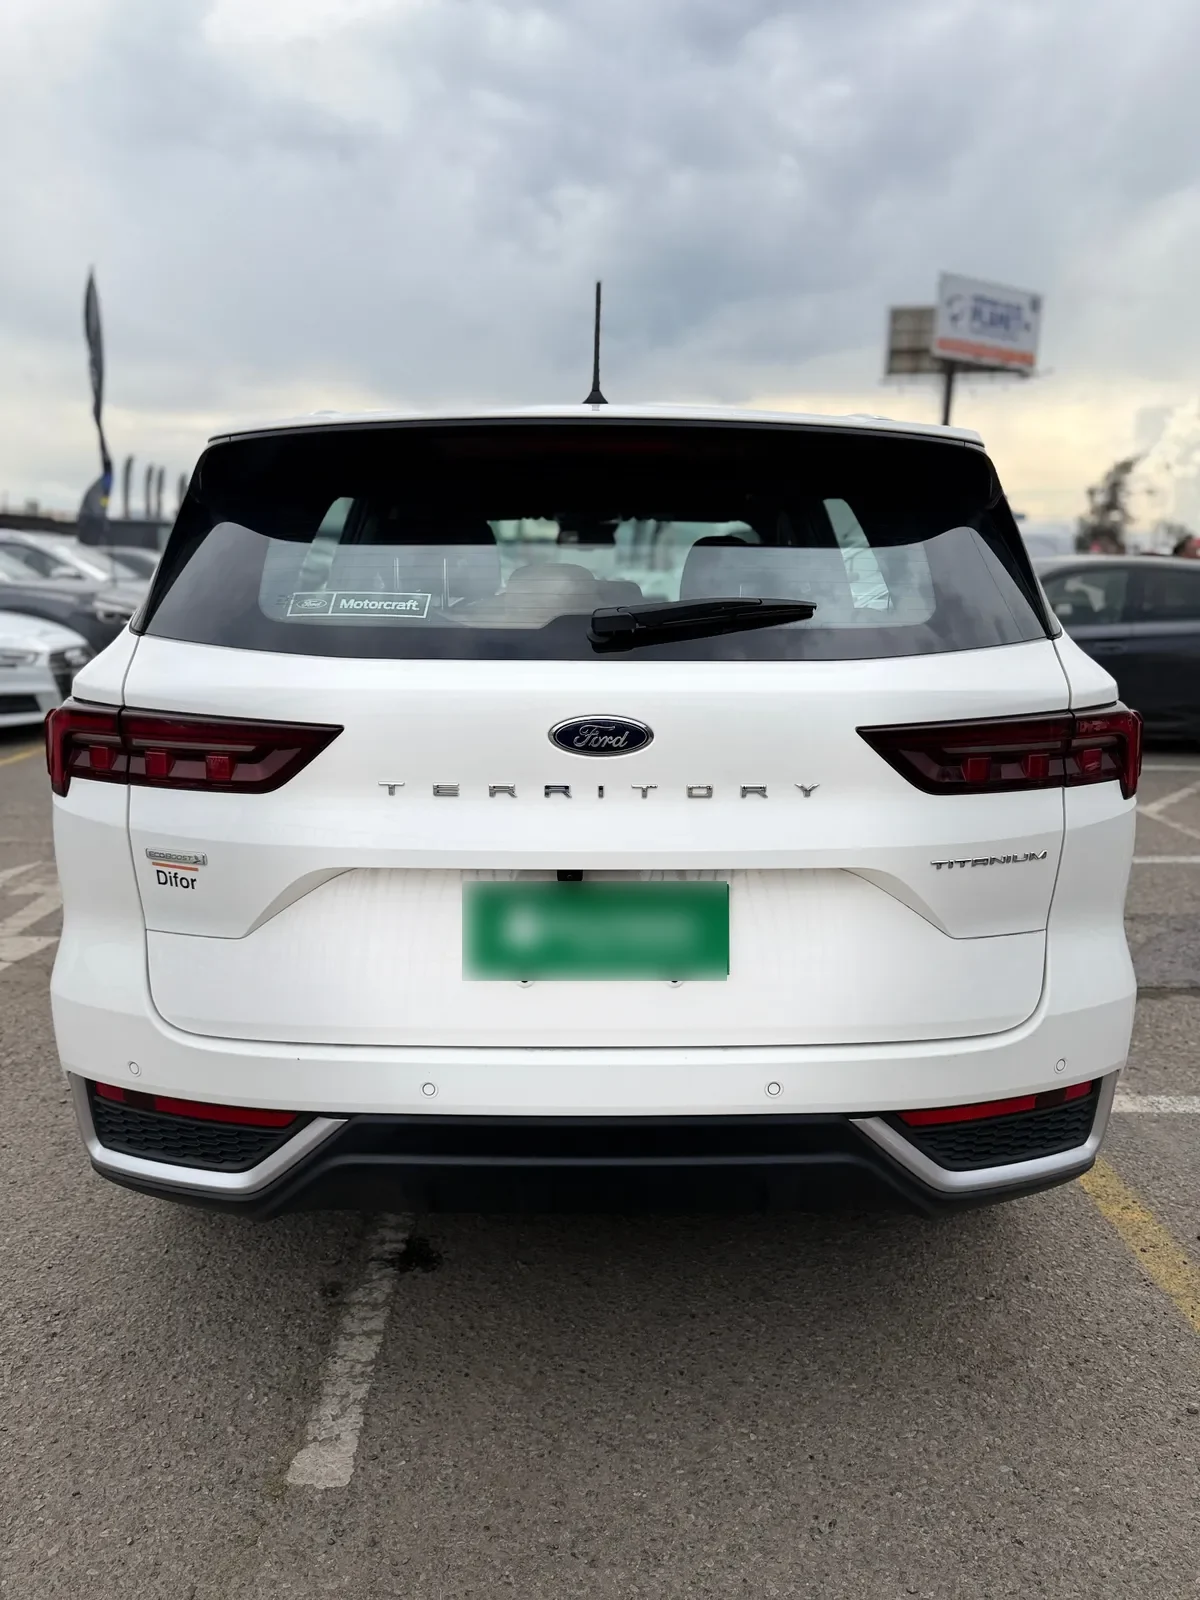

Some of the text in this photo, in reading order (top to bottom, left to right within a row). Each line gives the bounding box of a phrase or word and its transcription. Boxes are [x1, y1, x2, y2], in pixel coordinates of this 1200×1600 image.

[339, 599, 419, 611] Motorcraft
[573, 724, 630, 748] Ford
[378, 780, 821, 799] TERRITORY
[930, 850, 1047, 870] TITANIUM
[156, 869, 197, 890] Difor
